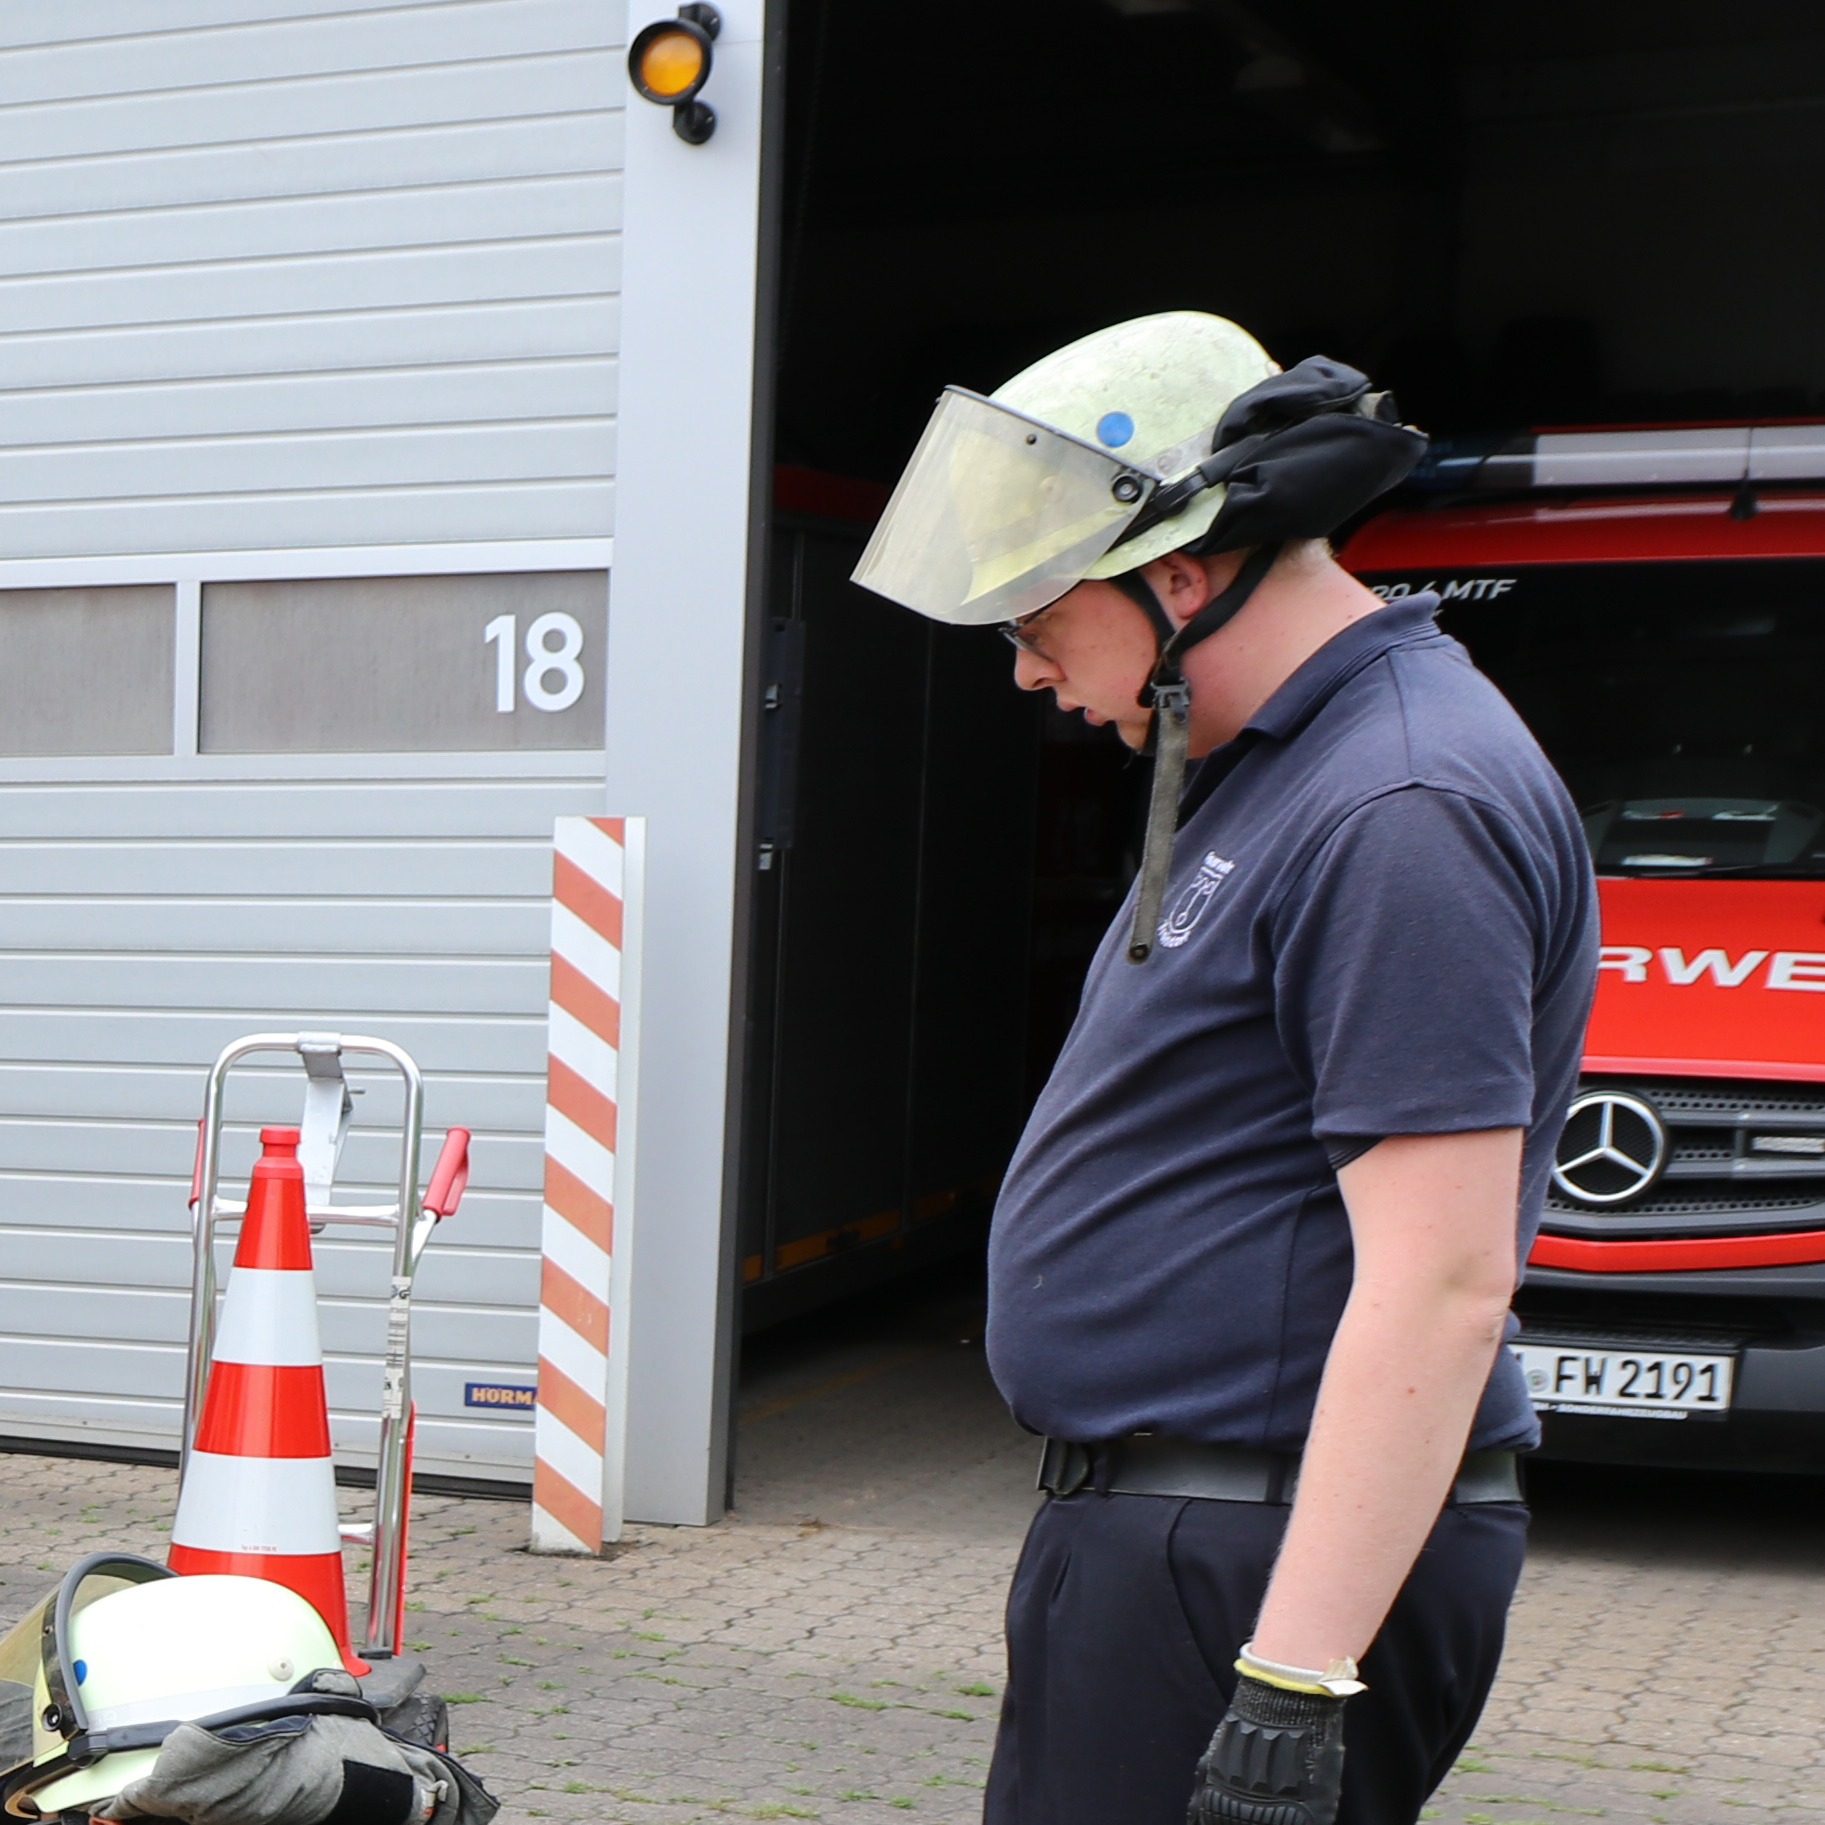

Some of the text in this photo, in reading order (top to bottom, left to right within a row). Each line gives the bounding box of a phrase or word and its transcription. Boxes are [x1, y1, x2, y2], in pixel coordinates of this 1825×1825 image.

[1442, 579, 1517, 600] MTF
[483, 612, 587, 713] 18
[471, 1386, 535, 1405] HÖRM
[1555, 1355, 1720, 1402] FW 2191
